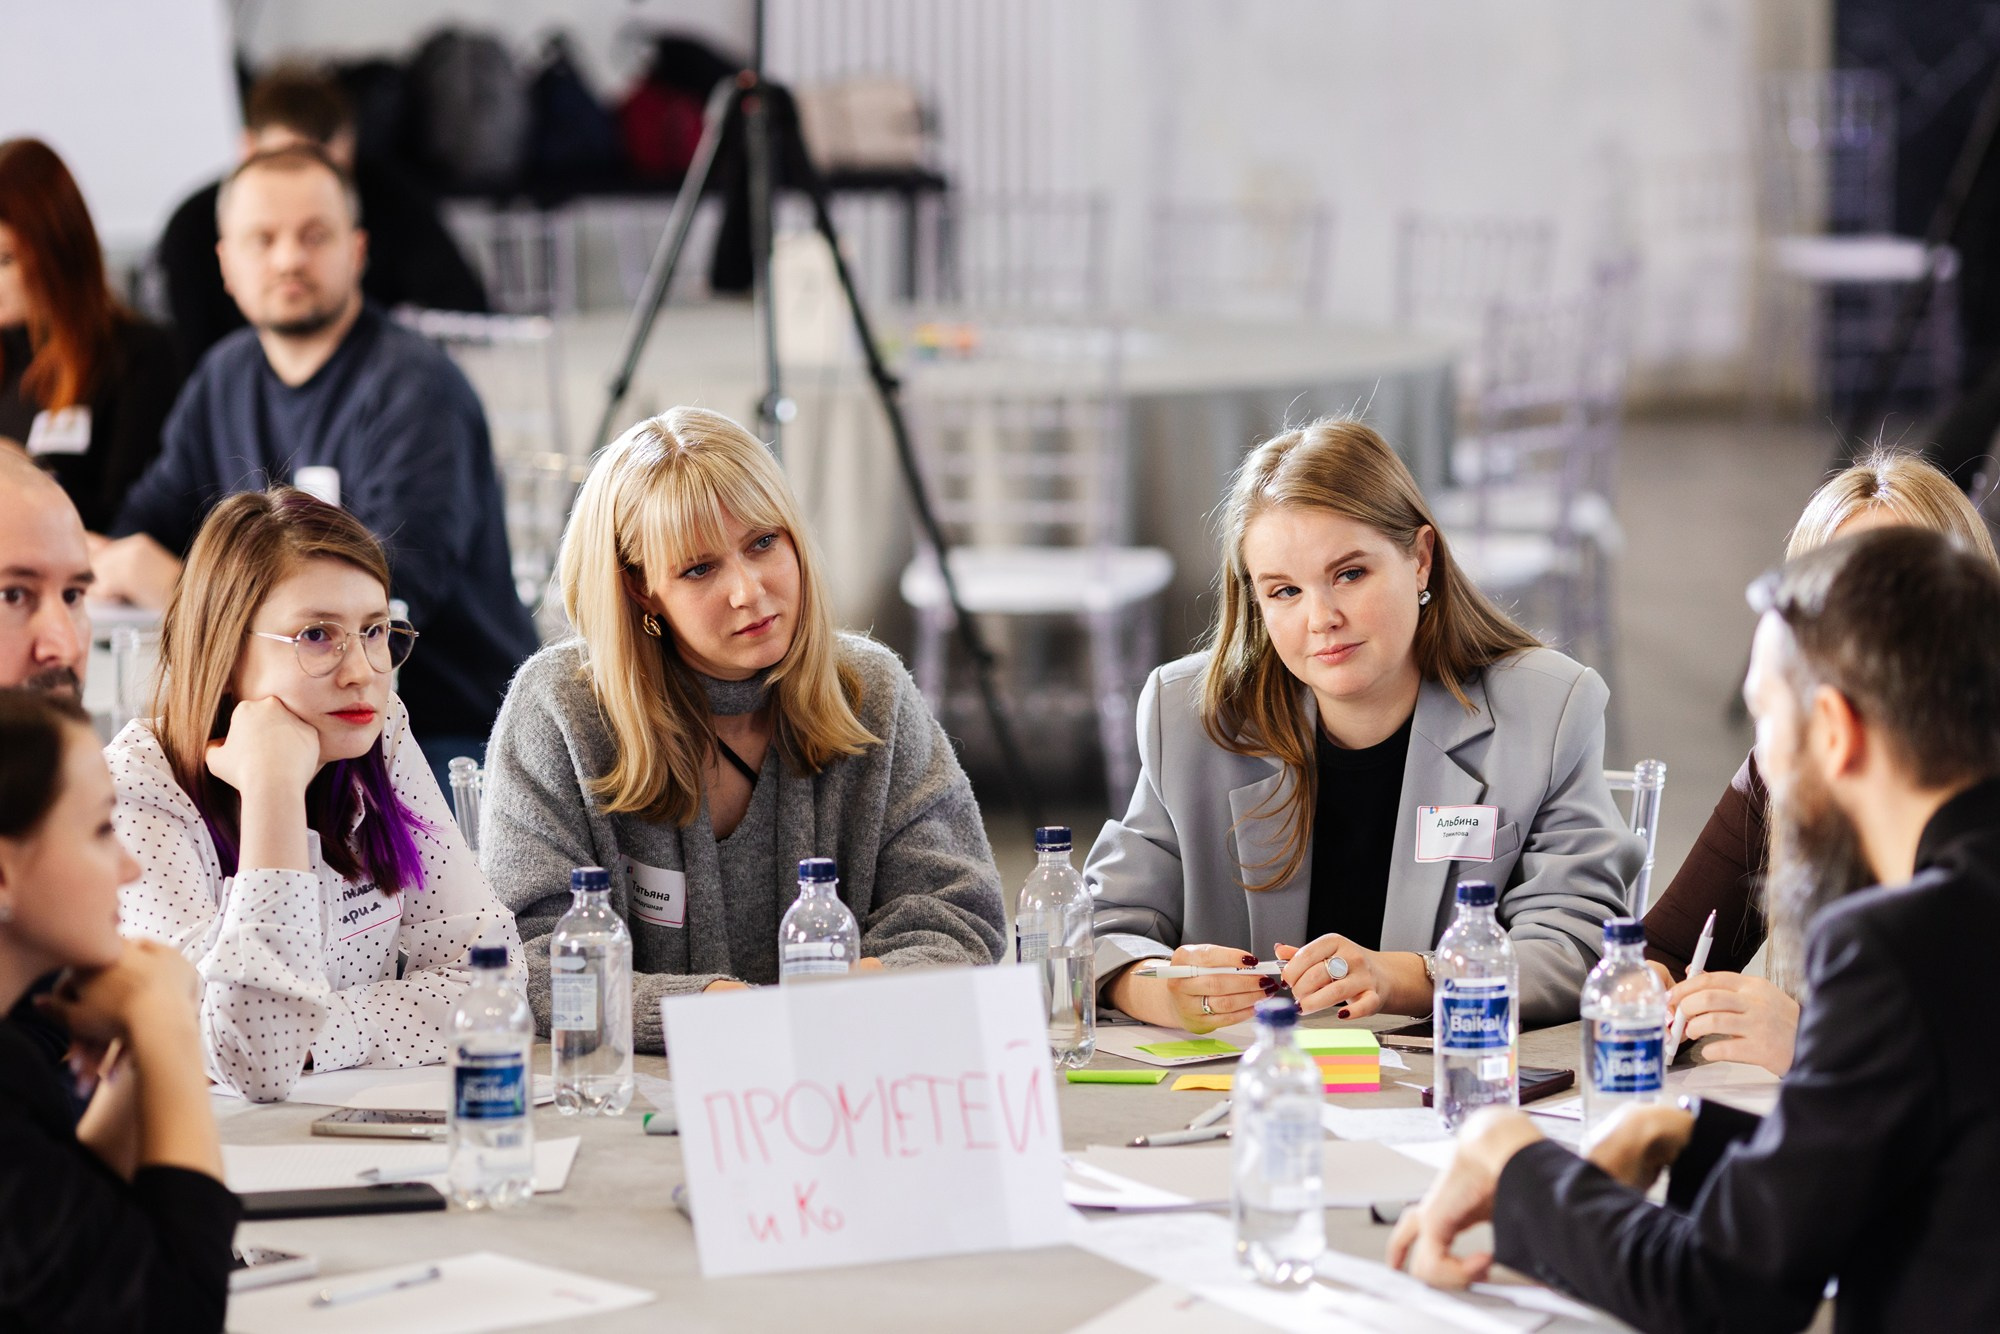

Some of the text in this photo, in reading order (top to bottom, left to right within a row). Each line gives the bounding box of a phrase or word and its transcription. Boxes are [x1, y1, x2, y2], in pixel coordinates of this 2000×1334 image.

[1437, 816, 1479, 828] Альбина
[632, 880, 671, 902] Татьяна
[1450, 1014, 1500, 1032] Baikal
[704, 1040, 1048, 1173] ПРОМЕТЕЙ
[748, 1179, 845, 1245] и Ко
